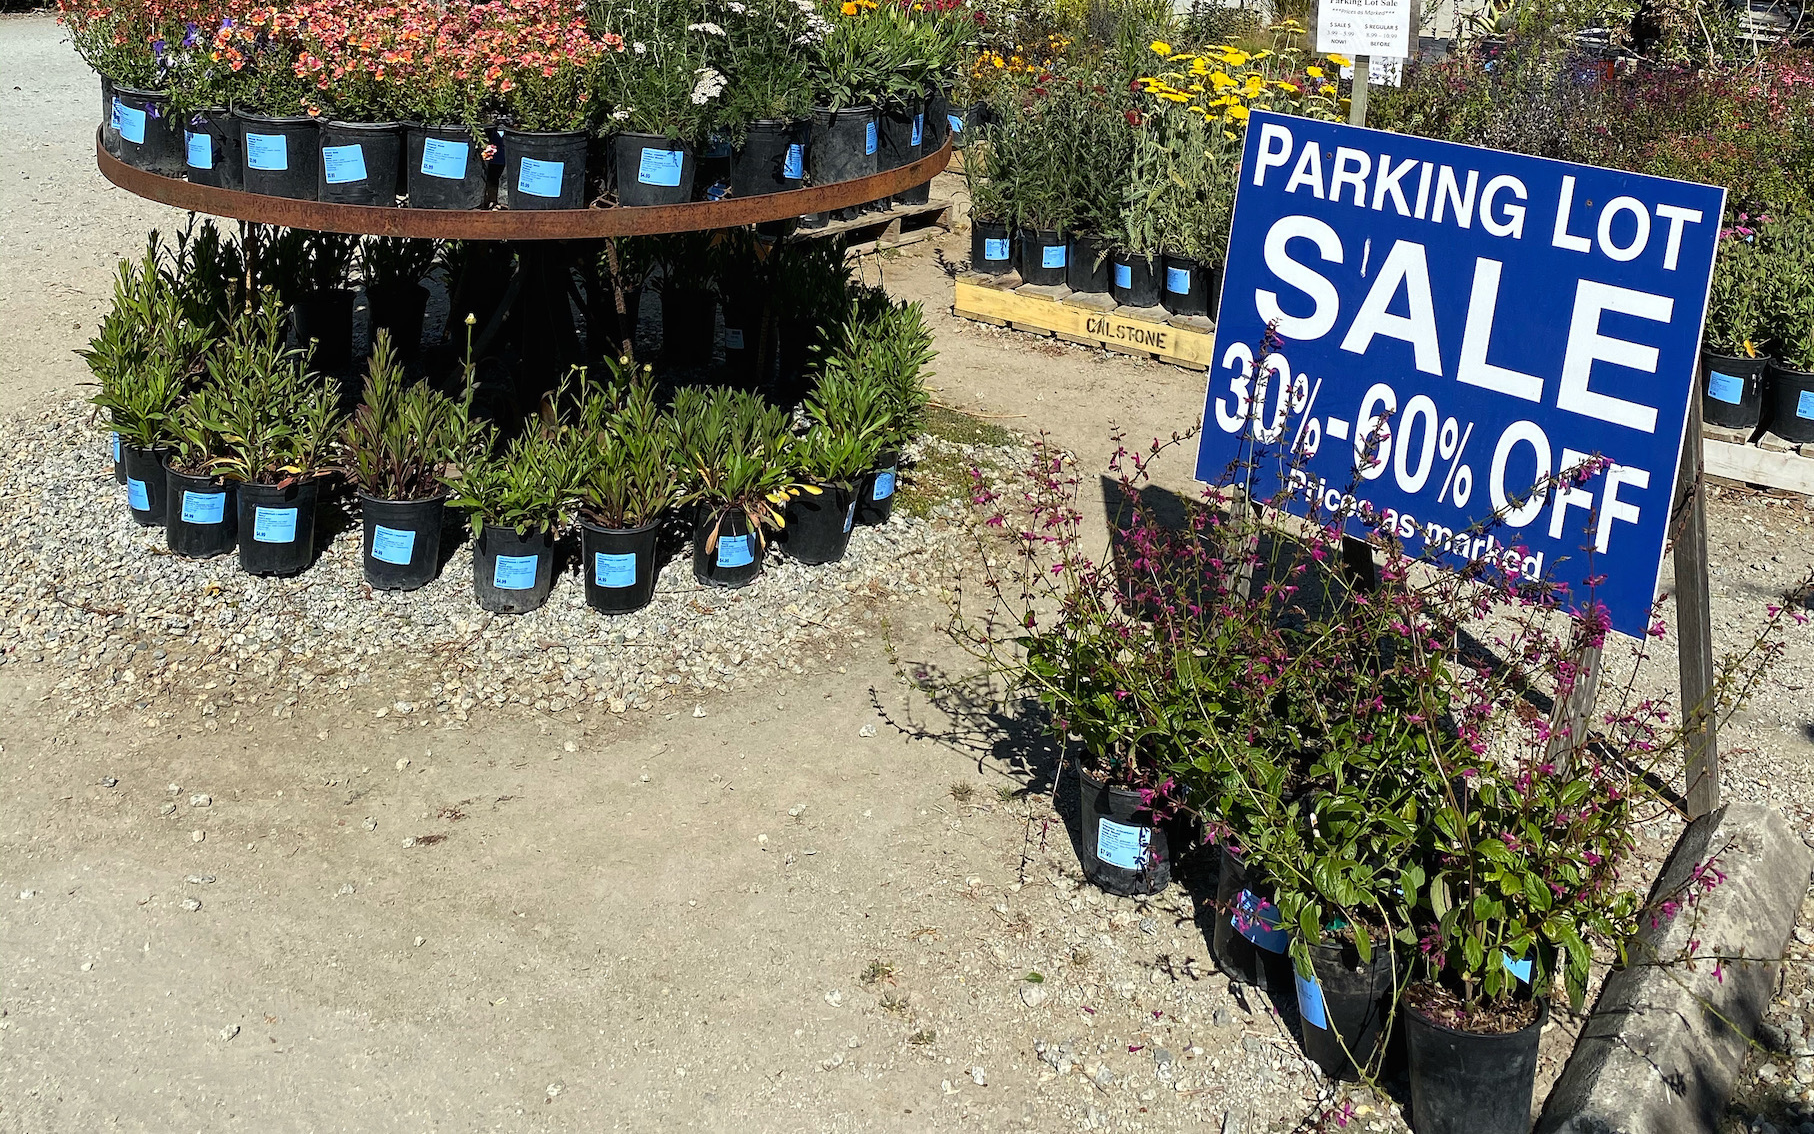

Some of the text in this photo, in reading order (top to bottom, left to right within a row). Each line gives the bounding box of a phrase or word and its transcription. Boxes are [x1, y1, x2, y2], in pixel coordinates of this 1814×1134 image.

[1380, 0, 1398, 7] Sale
[1253, 123, 1703, 272] PARKING LOT
[1086, 317, 1167, 349] CALSTONE
[1254, 214, 1675, 434] SALE
[1215, 341, 1651, 555] 30%-60% OFF
[1384, 508, 1415, 539] as
